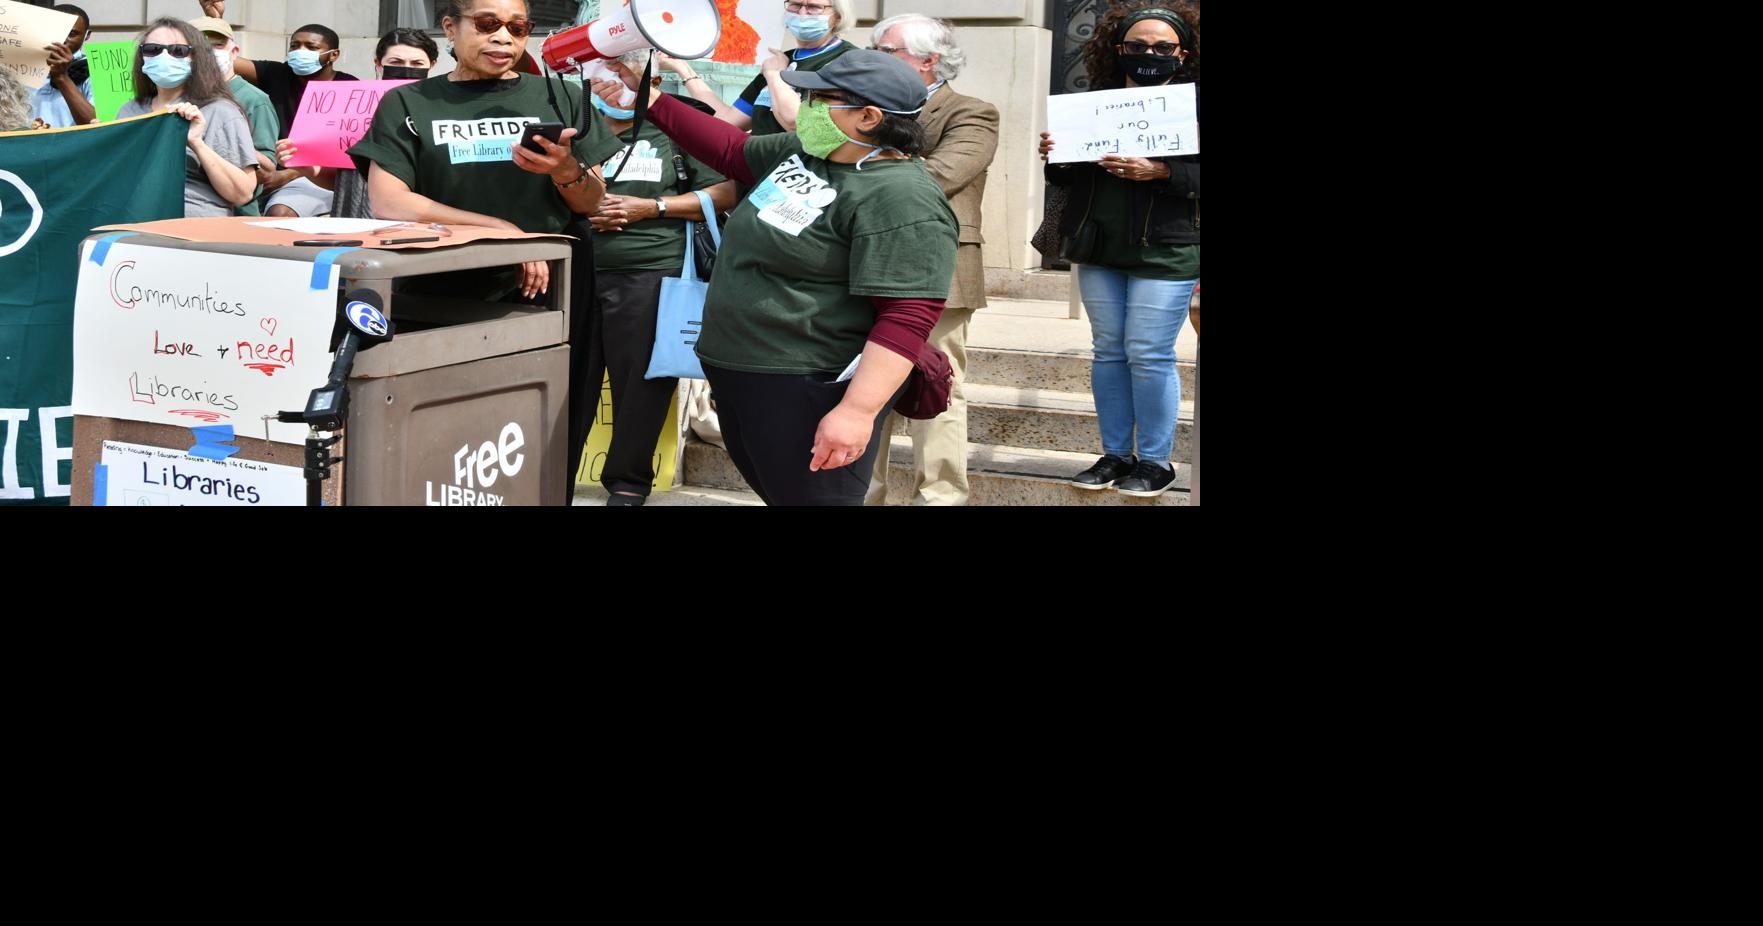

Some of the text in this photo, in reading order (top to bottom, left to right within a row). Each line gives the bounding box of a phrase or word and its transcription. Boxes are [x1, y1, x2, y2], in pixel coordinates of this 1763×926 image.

[608, 23, 626, 36] PYLE
[90, 47, 129, 71] FUND
[306, 89, 337, 114] NO
[339, 118, 358, 132] NO
[1117, 120, 1149, 130] Our
[452, 145, 471, 157] Free
[473, 144, 505, 159] Library
[1084, 133, 1180, 154] Fully Fund
[110, 260, 247, 317] Communities
[153, 330, 203, 357] Love
[236, 337, 295, 366] need
[129, 371, 239, 411] Libraries
[454, 422, 525, 489] Free
[142, 461, 261, 504] Libraries
[426, 480, 505, 506] LIBRARY
